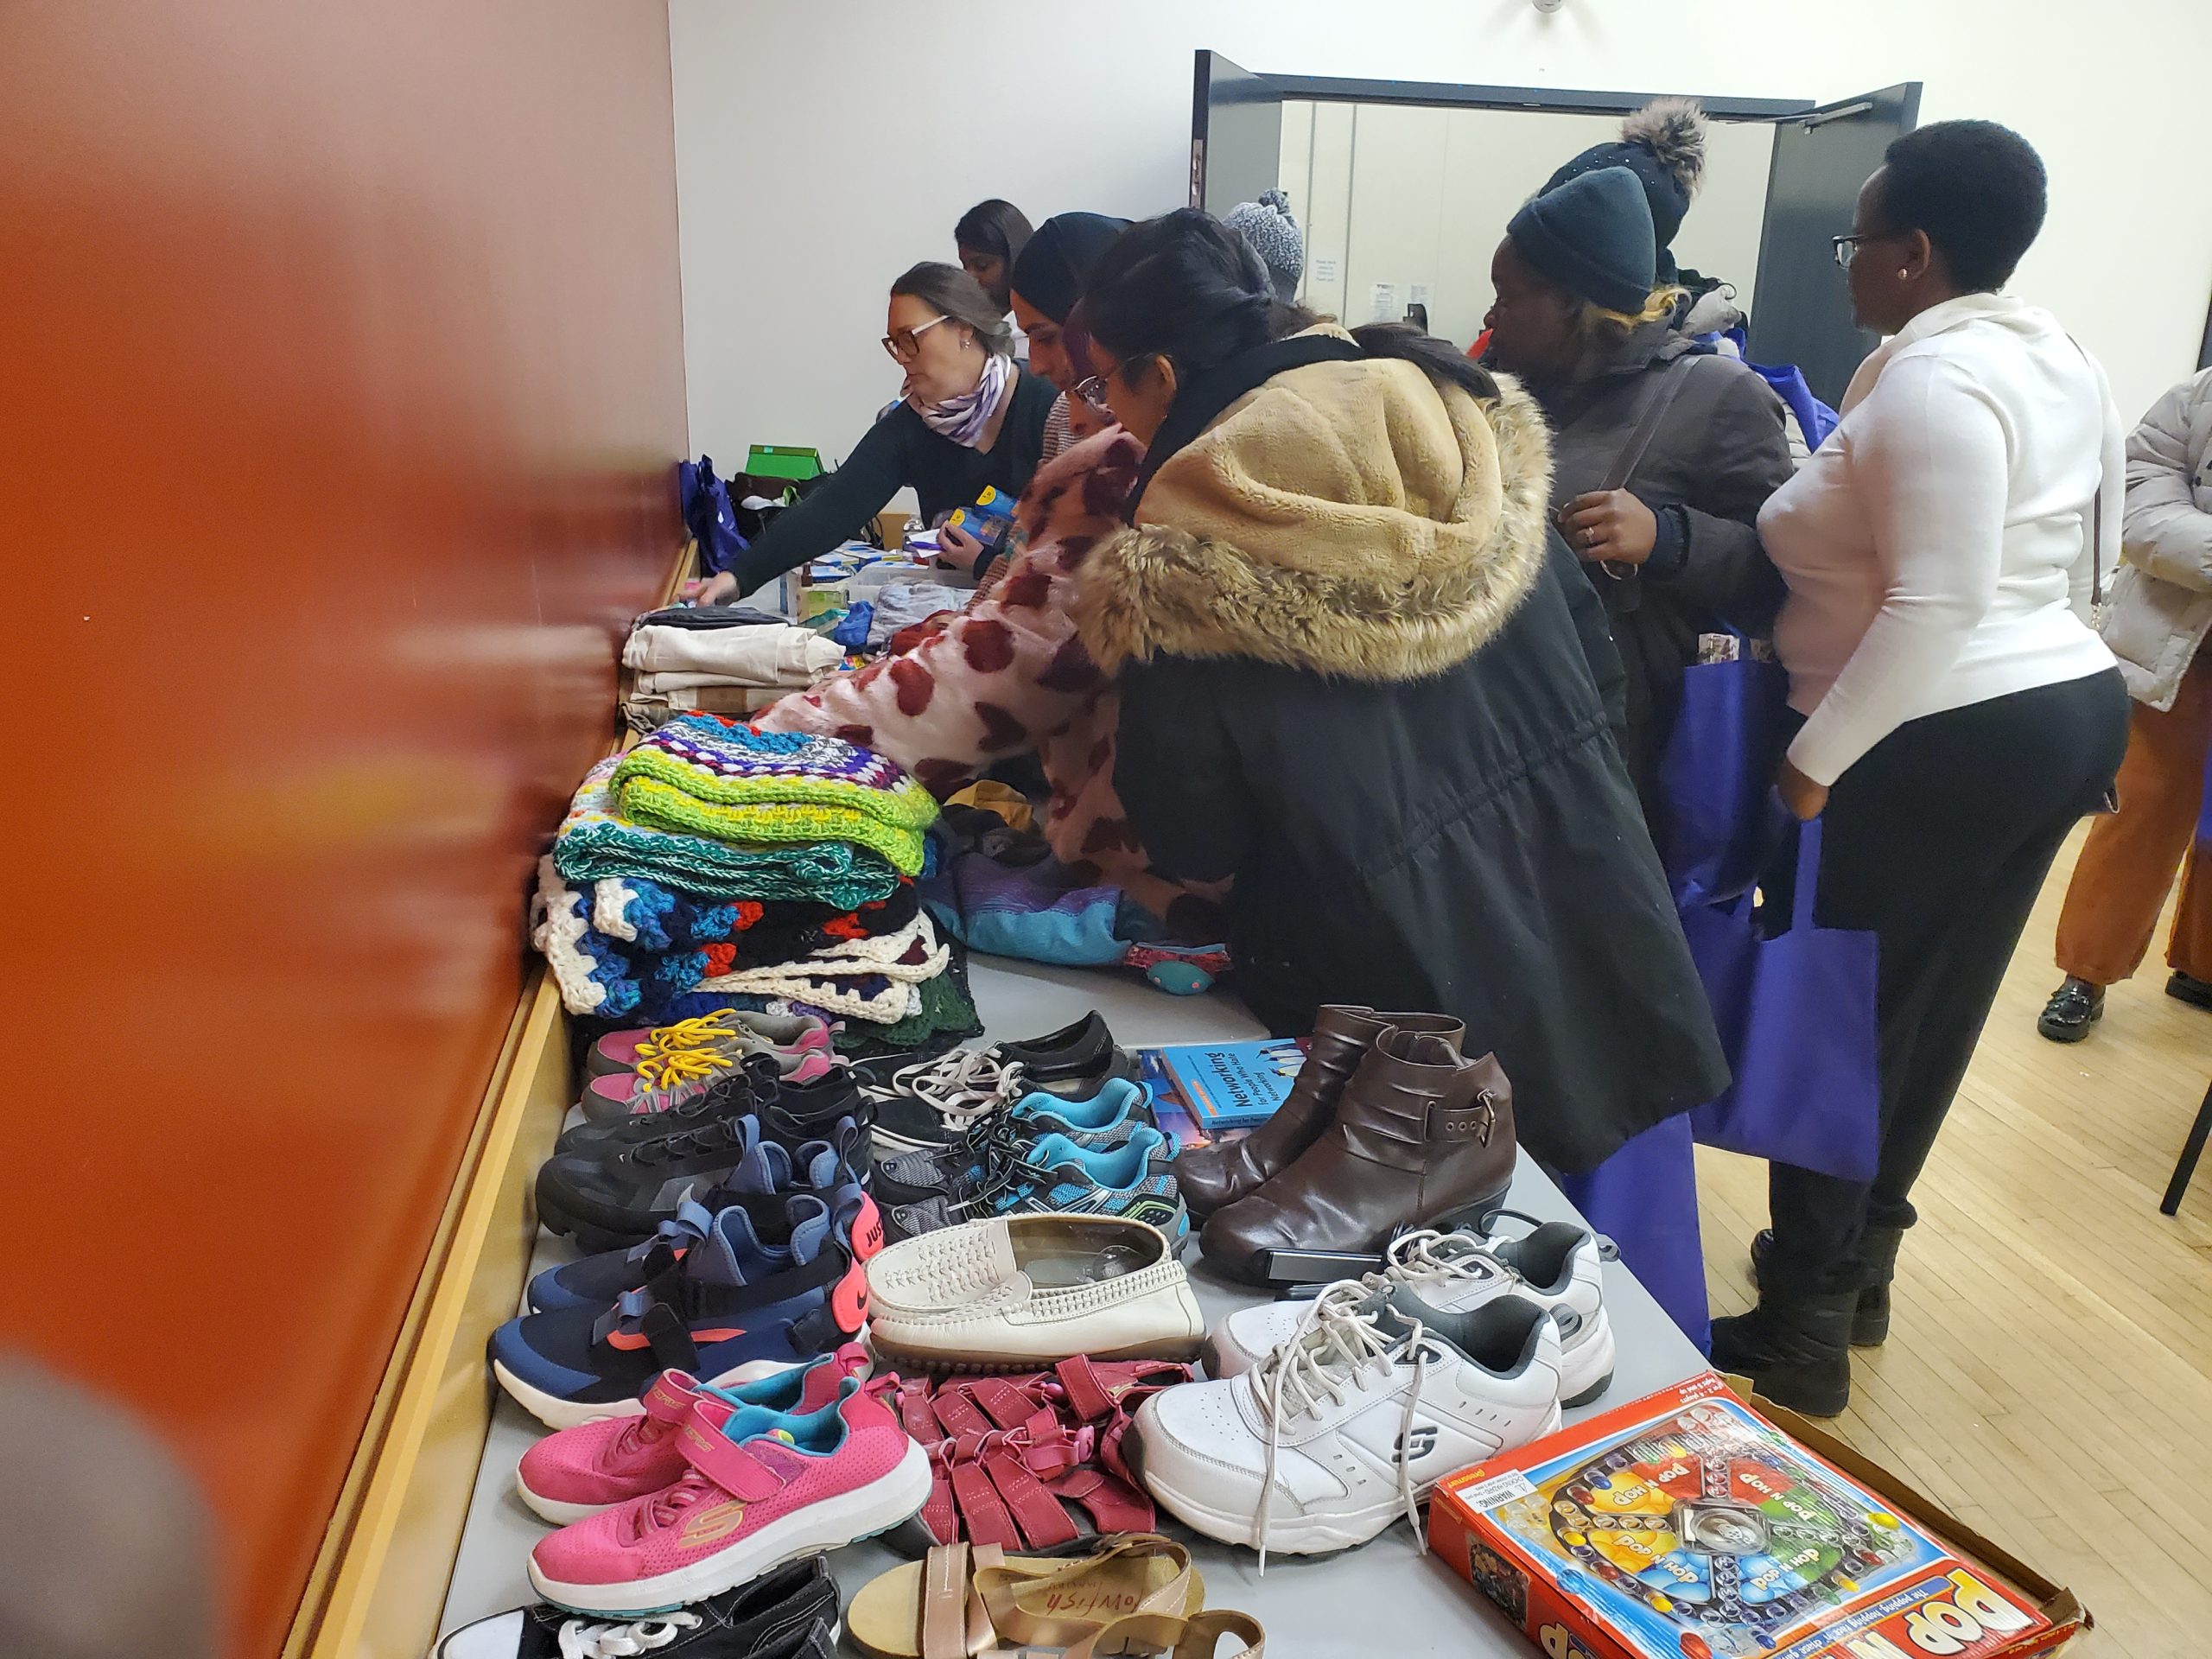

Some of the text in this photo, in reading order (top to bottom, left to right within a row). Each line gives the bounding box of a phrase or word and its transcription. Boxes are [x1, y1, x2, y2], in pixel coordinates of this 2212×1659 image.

[1228, 1052, 1241, 1066] Hate
[1236, 1065, 1249, 1078] Who
[1205, 1052, 1253, 1107] Networking
[1244, 1079, 1262, 1096] People
[1253, 1071, 1281, 1102] Networking
[1612, 1462, 1691, 1506] POP N HOP
[1477, 1490, 1516, 1509] WARNING:
[1738, 1473, 1818, 1521] POP N HOP
[1612, 1535, 1700, 1584] POP N HOP
[1750, 1548, 1821, 1592] POP N HOP
[1912, 1588, 1929, 1599] The
[1847, 1609, 1885, 1628] hopping
[1904, 1566, 2039, 1656] POP
[1799, 1638, 1823, 1655] chase
